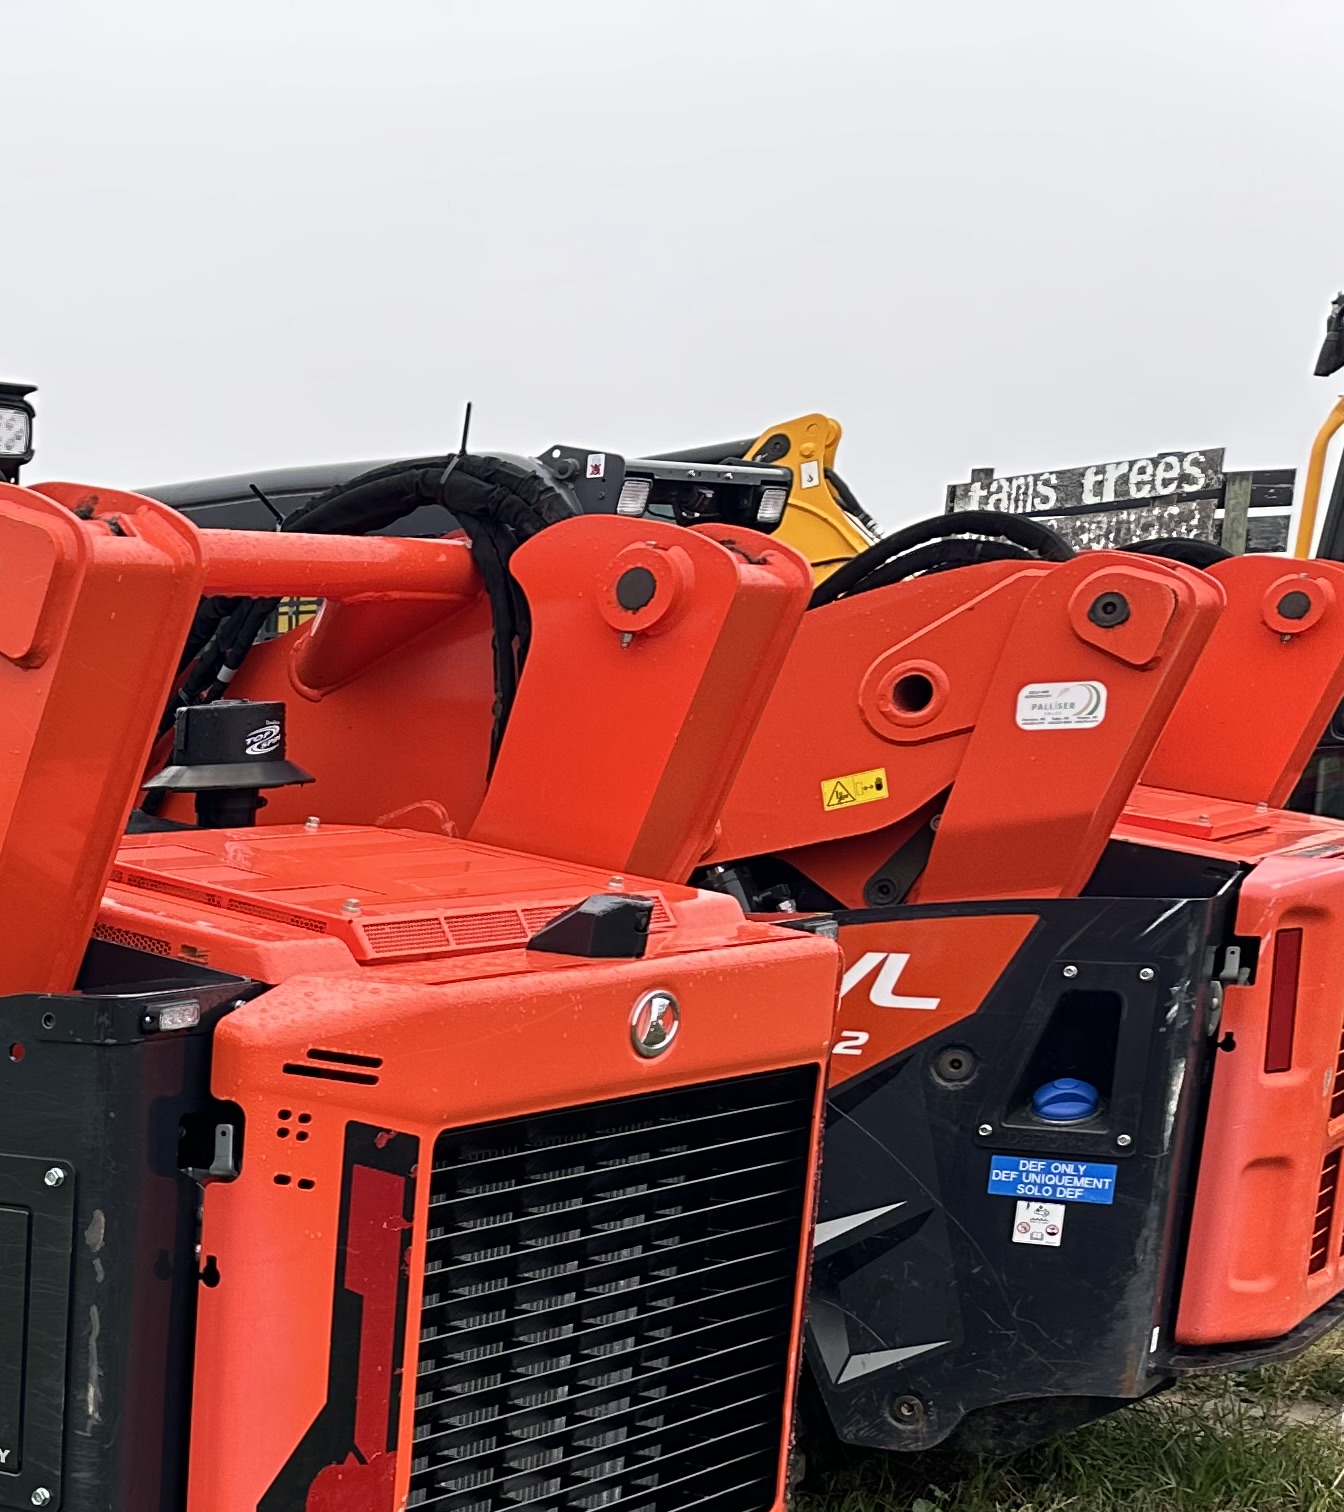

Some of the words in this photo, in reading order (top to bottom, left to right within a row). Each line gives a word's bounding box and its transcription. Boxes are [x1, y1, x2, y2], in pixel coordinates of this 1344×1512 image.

[1081, 451, 1206, 503] trees
[1019, 1160, 1047, 1172] DEF
[1051, 1162, 1087, 1176] ONLY
[992, 1170, 1019, 1182] DEF
[1022, 1174, 1112, 1190] UNIQUEMENT
[1016, 1184, 1052, 1197] SOLO
[1056, 1188, 1084, 1199] DEF
